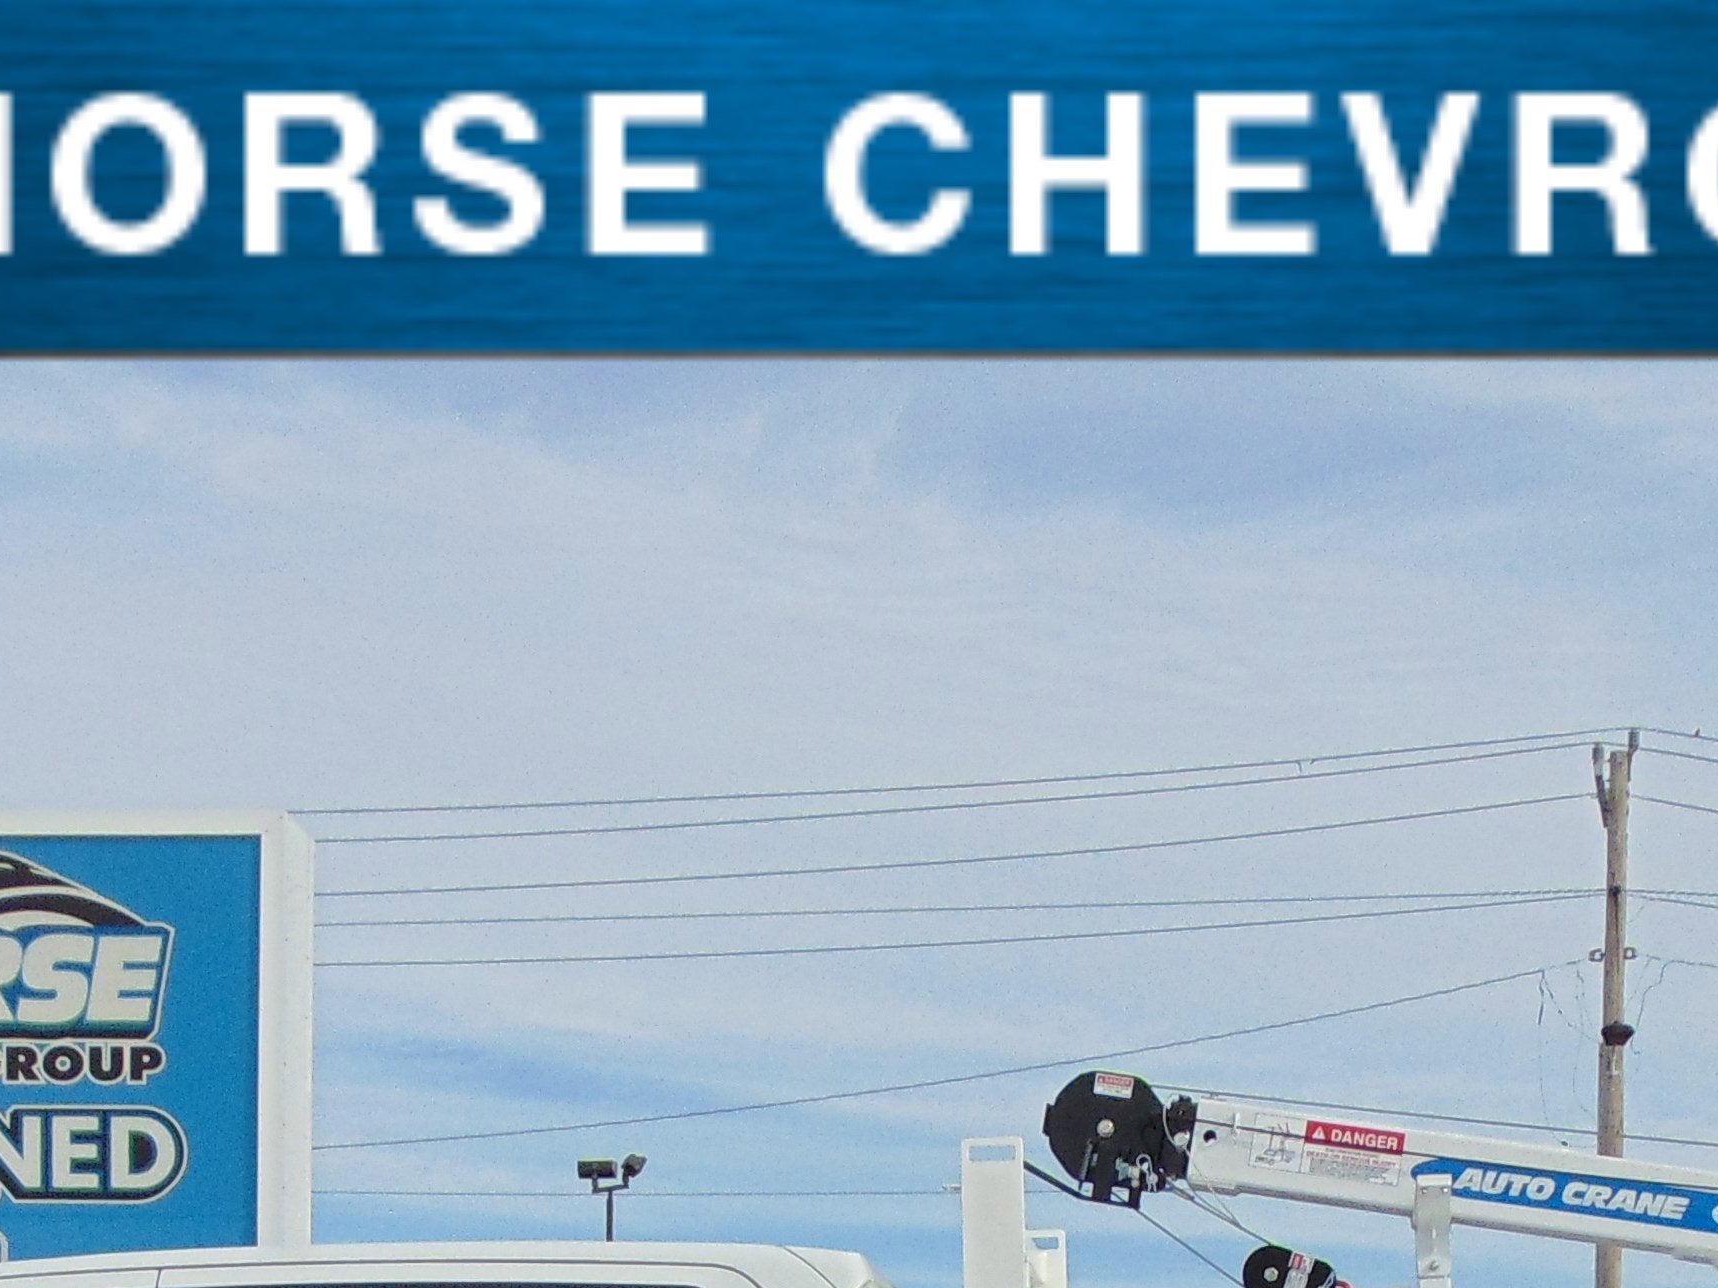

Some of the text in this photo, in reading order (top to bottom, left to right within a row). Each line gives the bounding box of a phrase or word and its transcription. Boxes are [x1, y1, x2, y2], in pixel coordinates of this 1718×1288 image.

[1330, 1128, 1398, 1151] DANGER
[1452, 1167, 1556, 1201] AUTO
[1562, 1181, 1691, 1221] CRANE
